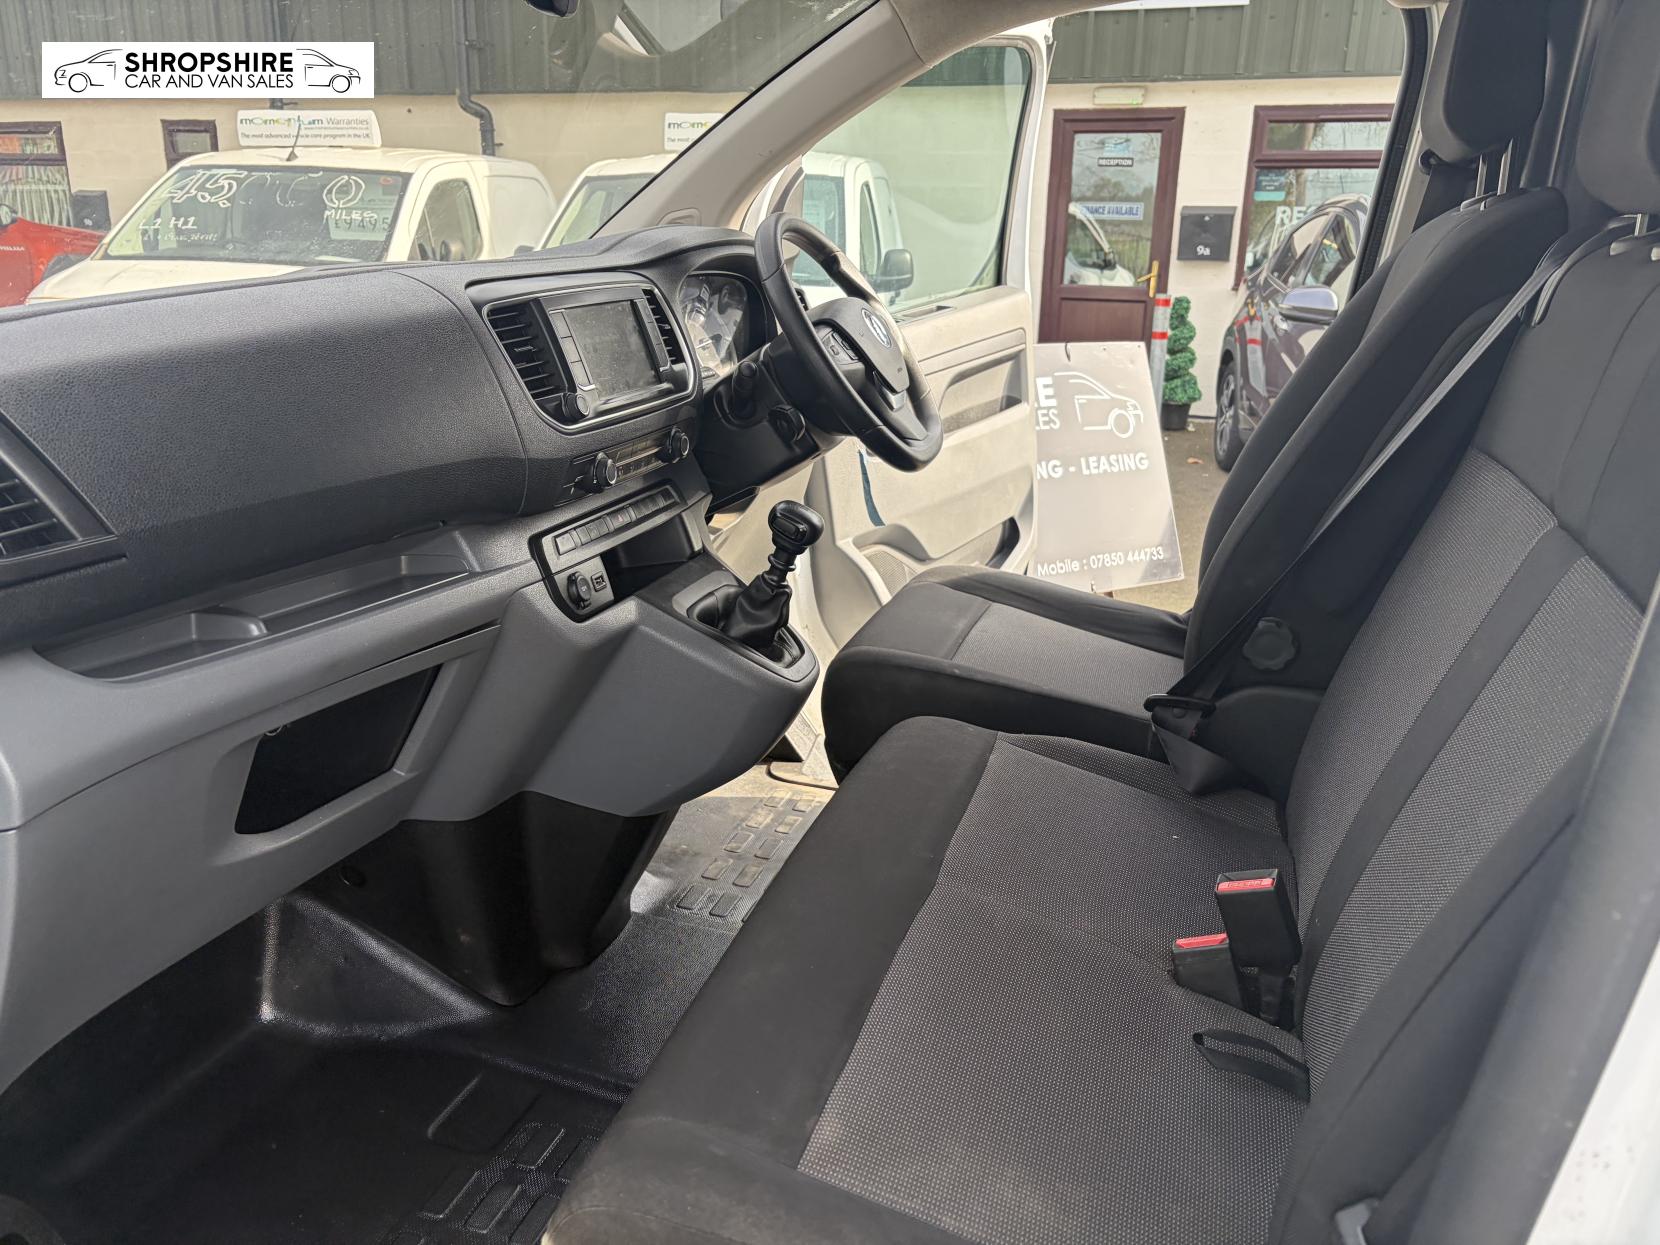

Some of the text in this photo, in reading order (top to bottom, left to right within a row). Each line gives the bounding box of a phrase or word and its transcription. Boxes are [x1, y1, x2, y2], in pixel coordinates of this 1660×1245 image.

[326, 117, 369, 126] Warranties
[324, 209, 378, 221] MILES
[1107, 205, 1139, 217] AVAILABLE
[169, 216, 197, 229] H1
[1196, 244, 1211, 256] 9a
[1080, 452, 1149, 475] LEASING
[1037, 559, 1080, 577] Mobile
[1089, 551, 1124, 569] 07850
[1126, 546, 1164, 562] 444733
